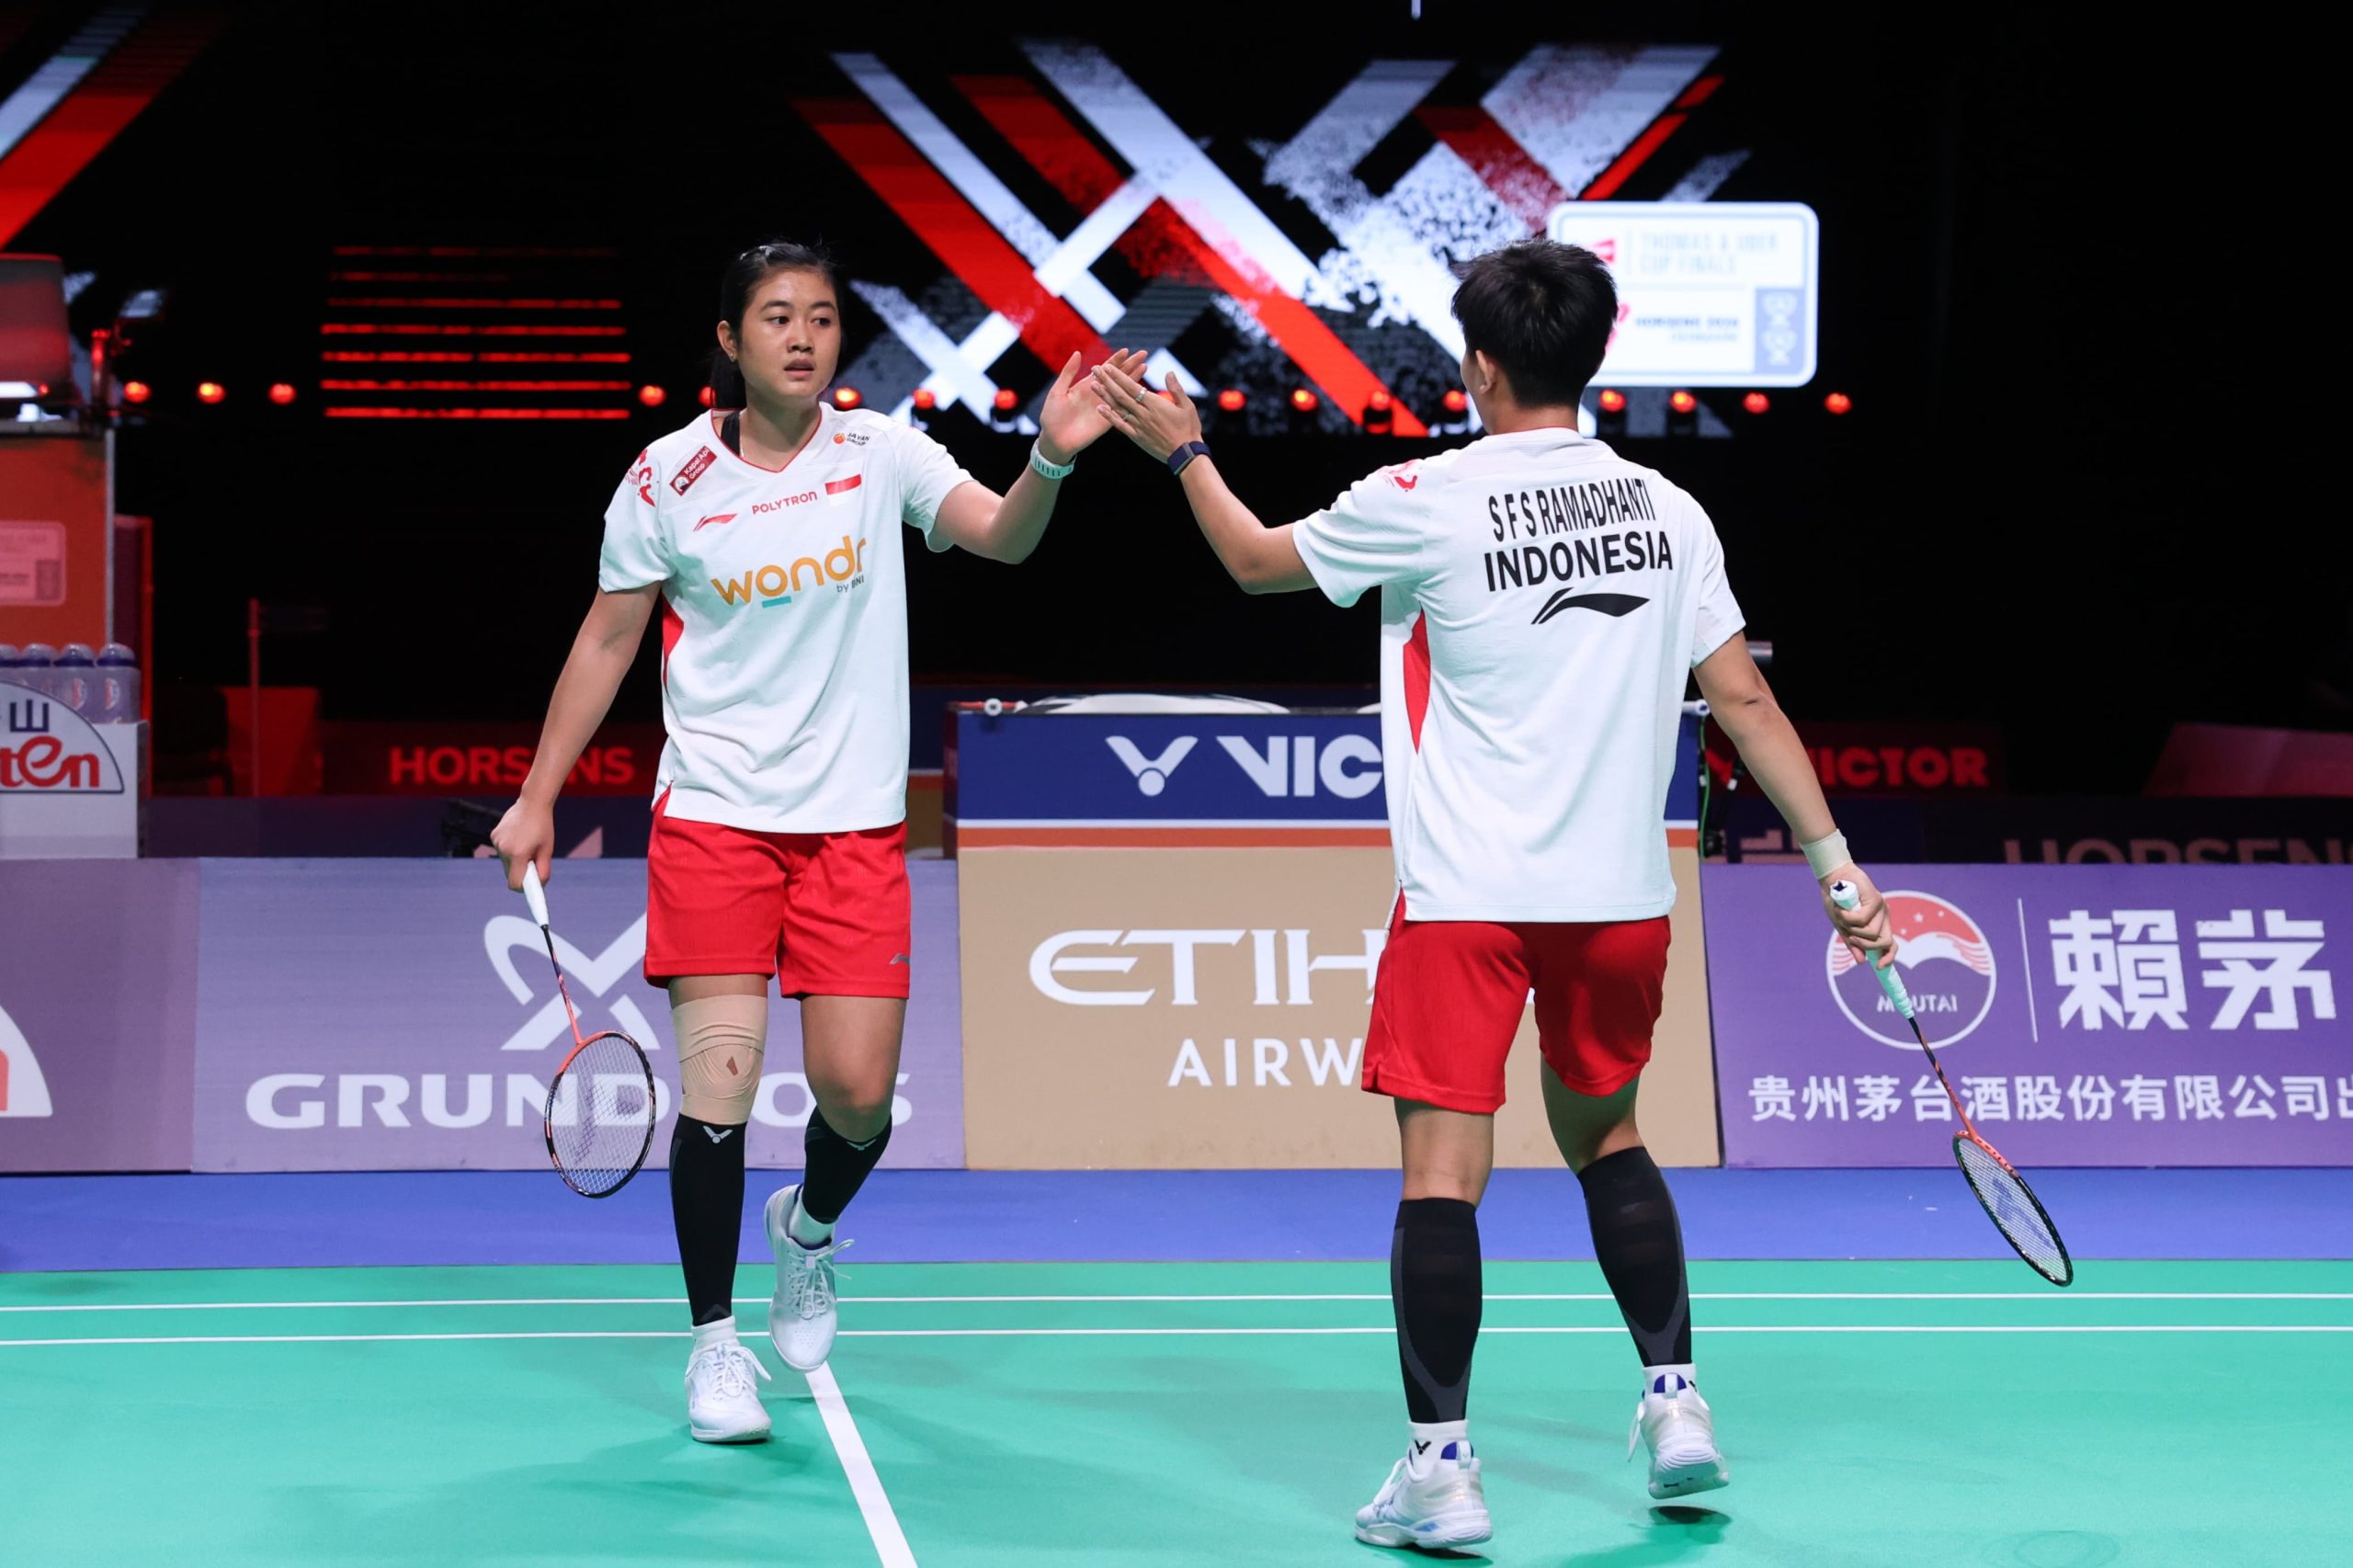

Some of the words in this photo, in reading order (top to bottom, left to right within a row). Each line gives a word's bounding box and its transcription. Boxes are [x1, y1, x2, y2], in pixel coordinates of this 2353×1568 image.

[752, 491, 818, 515] POLYTRON
[1488, 495, 1505, 542] S
[1505, 494, 1518, 540] F
[1520, 492, 1537, 537] S
[1536, 478, 1656, 535] RAMADHANTI
[710, 535, 867, 606] wondr
[836, 584, 849, 593] by
[851, 575, 865, 588] BNI
[1484, 530, 1673, 592] INDONESIA
[389, 746, 635, 786] HORSNS
[1216, 734, 1383, 799] VIC
[1809, 745, 1989, 788] ICTOR
[1029, 929, 1389, 1006] ETIH
[1877, 994, 1958, 1013] MUTAI
[1168, 1038, 1362, 1087] AIRW
[245, 1073, 913, 1130] GRUNDO
